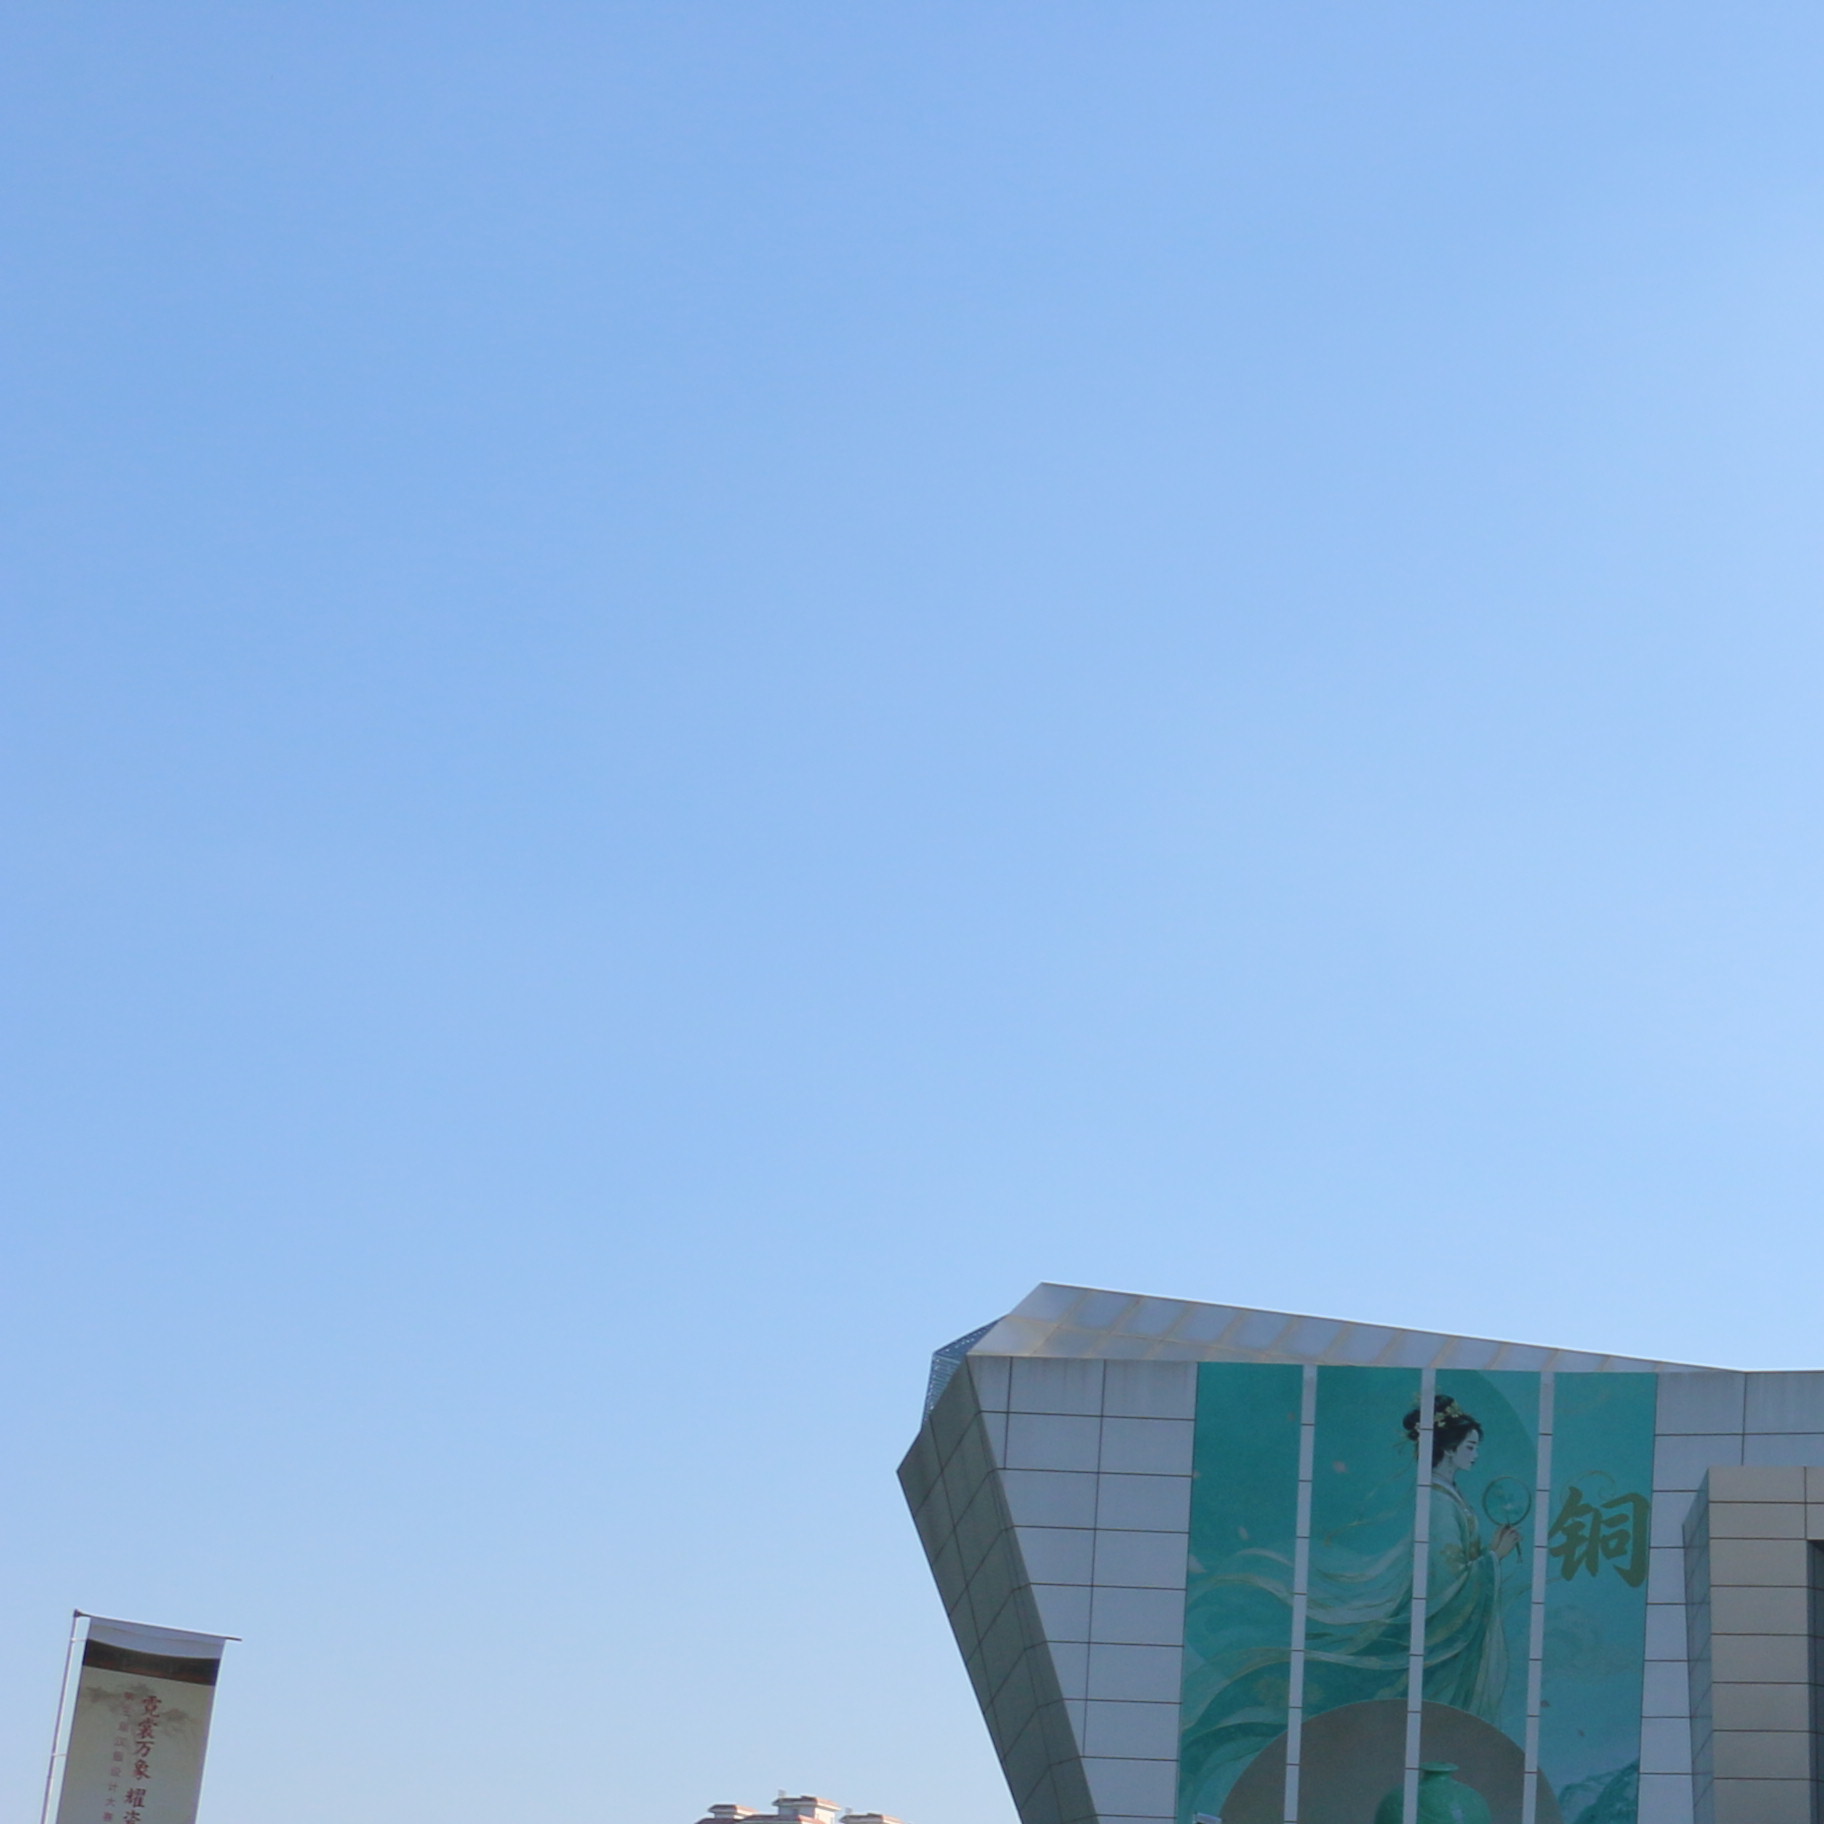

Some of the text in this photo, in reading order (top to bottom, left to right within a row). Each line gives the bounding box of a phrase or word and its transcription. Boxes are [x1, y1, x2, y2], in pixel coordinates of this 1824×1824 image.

[1547, 1486, 1651, 1589] 铜
[132, 1695, 162, 1781] 霓裳万象
